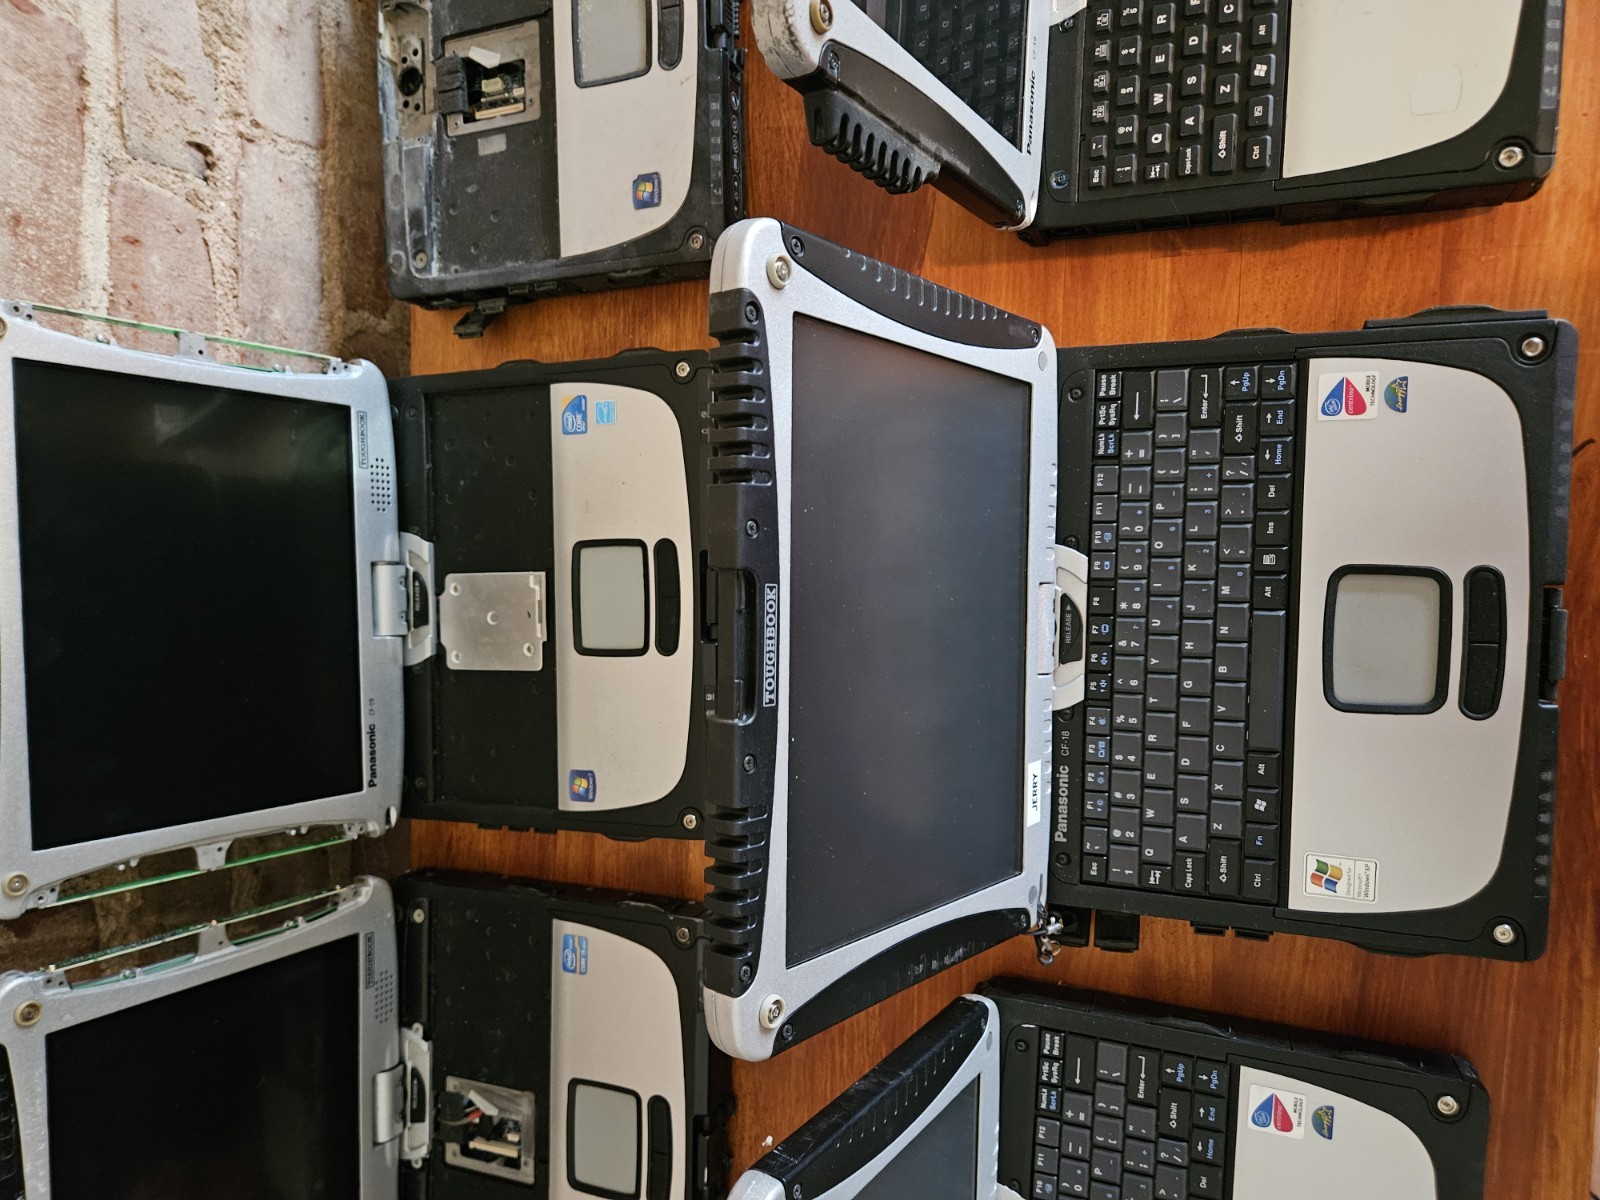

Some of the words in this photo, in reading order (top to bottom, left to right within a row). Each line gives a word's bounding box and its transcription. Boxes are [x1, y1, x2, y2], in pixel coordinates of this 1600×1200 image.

[1224, 4, 1234, 13] C
[1157, 14, 1166, 24] R
[1189, 36, 1198, 45] D
[1222, 44, 1232, 54] X
[1155, 54, 1165, 63] E
[1187, 76, 1196, 84] S
[1220, 84, 1230, 94] Z
[1154, 93, 1163, 105] W
[1026, 70, 1036, 156] Panasonic
[1185, 116, 1194, 125] A
[1152, 133, 1162, 143] Q
[1218, 130, 1226, 149] Shift
[1242, 372, 1250, 392] PgUp
[1278, 370, 1286, 390] PgDn
[1108, 403, 1117, 426] SysRq
[1094, 561, 1100, 570] F9
[1221, 586, 1230, 594] M
[1093, 597, 1100, 606] F8
[1092, 625, 1098, 634] F7
[766, 587, 776, 702] TOUGHBOOK
[1091, 654, 1098, 662] F6
[1090, 682, 1097, 690] F5
[1089, 716, 1096, 725] F4
[1061, 731, 1070, 756] CF-18
[1088, 744, 1095, 753] F3
[366, 723, 378, 788] Panasonic
[1088, 772, 1094, 782] F2
[1054, 765, 1069, 842] Panasonic
[1087, 801, 1094, 809] F1
[1146, 808, 1154, 818] W
[1256, 836, 1262, 845] Fn
[1185, 873, 1193, 888] Caps
[1176, 1063, 1185, 1082] PgUp
[1210, 1070, 1218, 1089] PgDn
